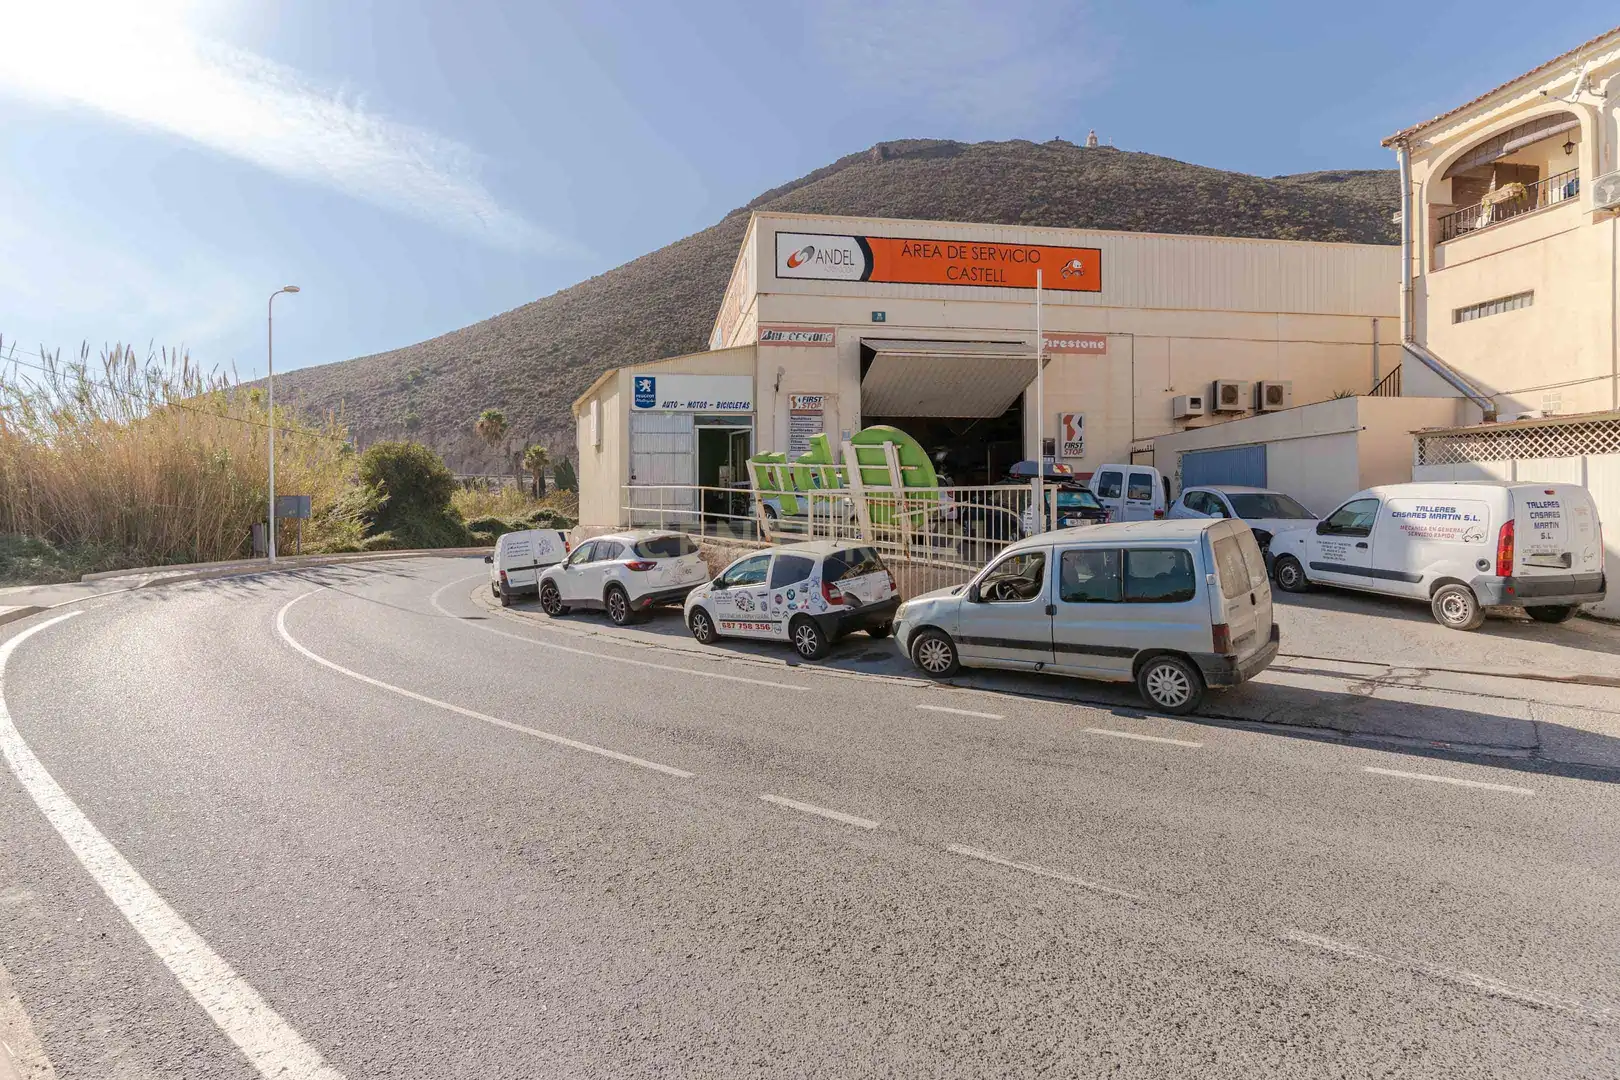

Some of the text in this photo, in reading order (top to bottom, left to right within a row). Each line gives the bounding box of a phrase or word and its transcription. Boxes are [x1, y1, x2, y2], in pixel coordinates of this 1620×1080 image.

[901, 241, 1041, 264] ÁREA DE SERVICIO
[815, 249, 855, 266] ANDEL
[946, 265, 1007, 283] CASTELL
[761, 330, 834, 342] BRIGESTONE
[662, 401, 678, 409] AUTO
[687, 401, 708, 409] MOTOS
[716, 401, 751, 410] BICICLETAS
[1415, 505, 1456, 513] TALLERES
[1526, 501, 1561, 509] TALLERES
[1392, 511, 1481, 522] CASARES MARTIN S.L.
[1529, 511, 1561, 519] CASARES
[1534, 521, 1560, 529] MARTIN
[1540, 532, 1554, 540] S.L.
